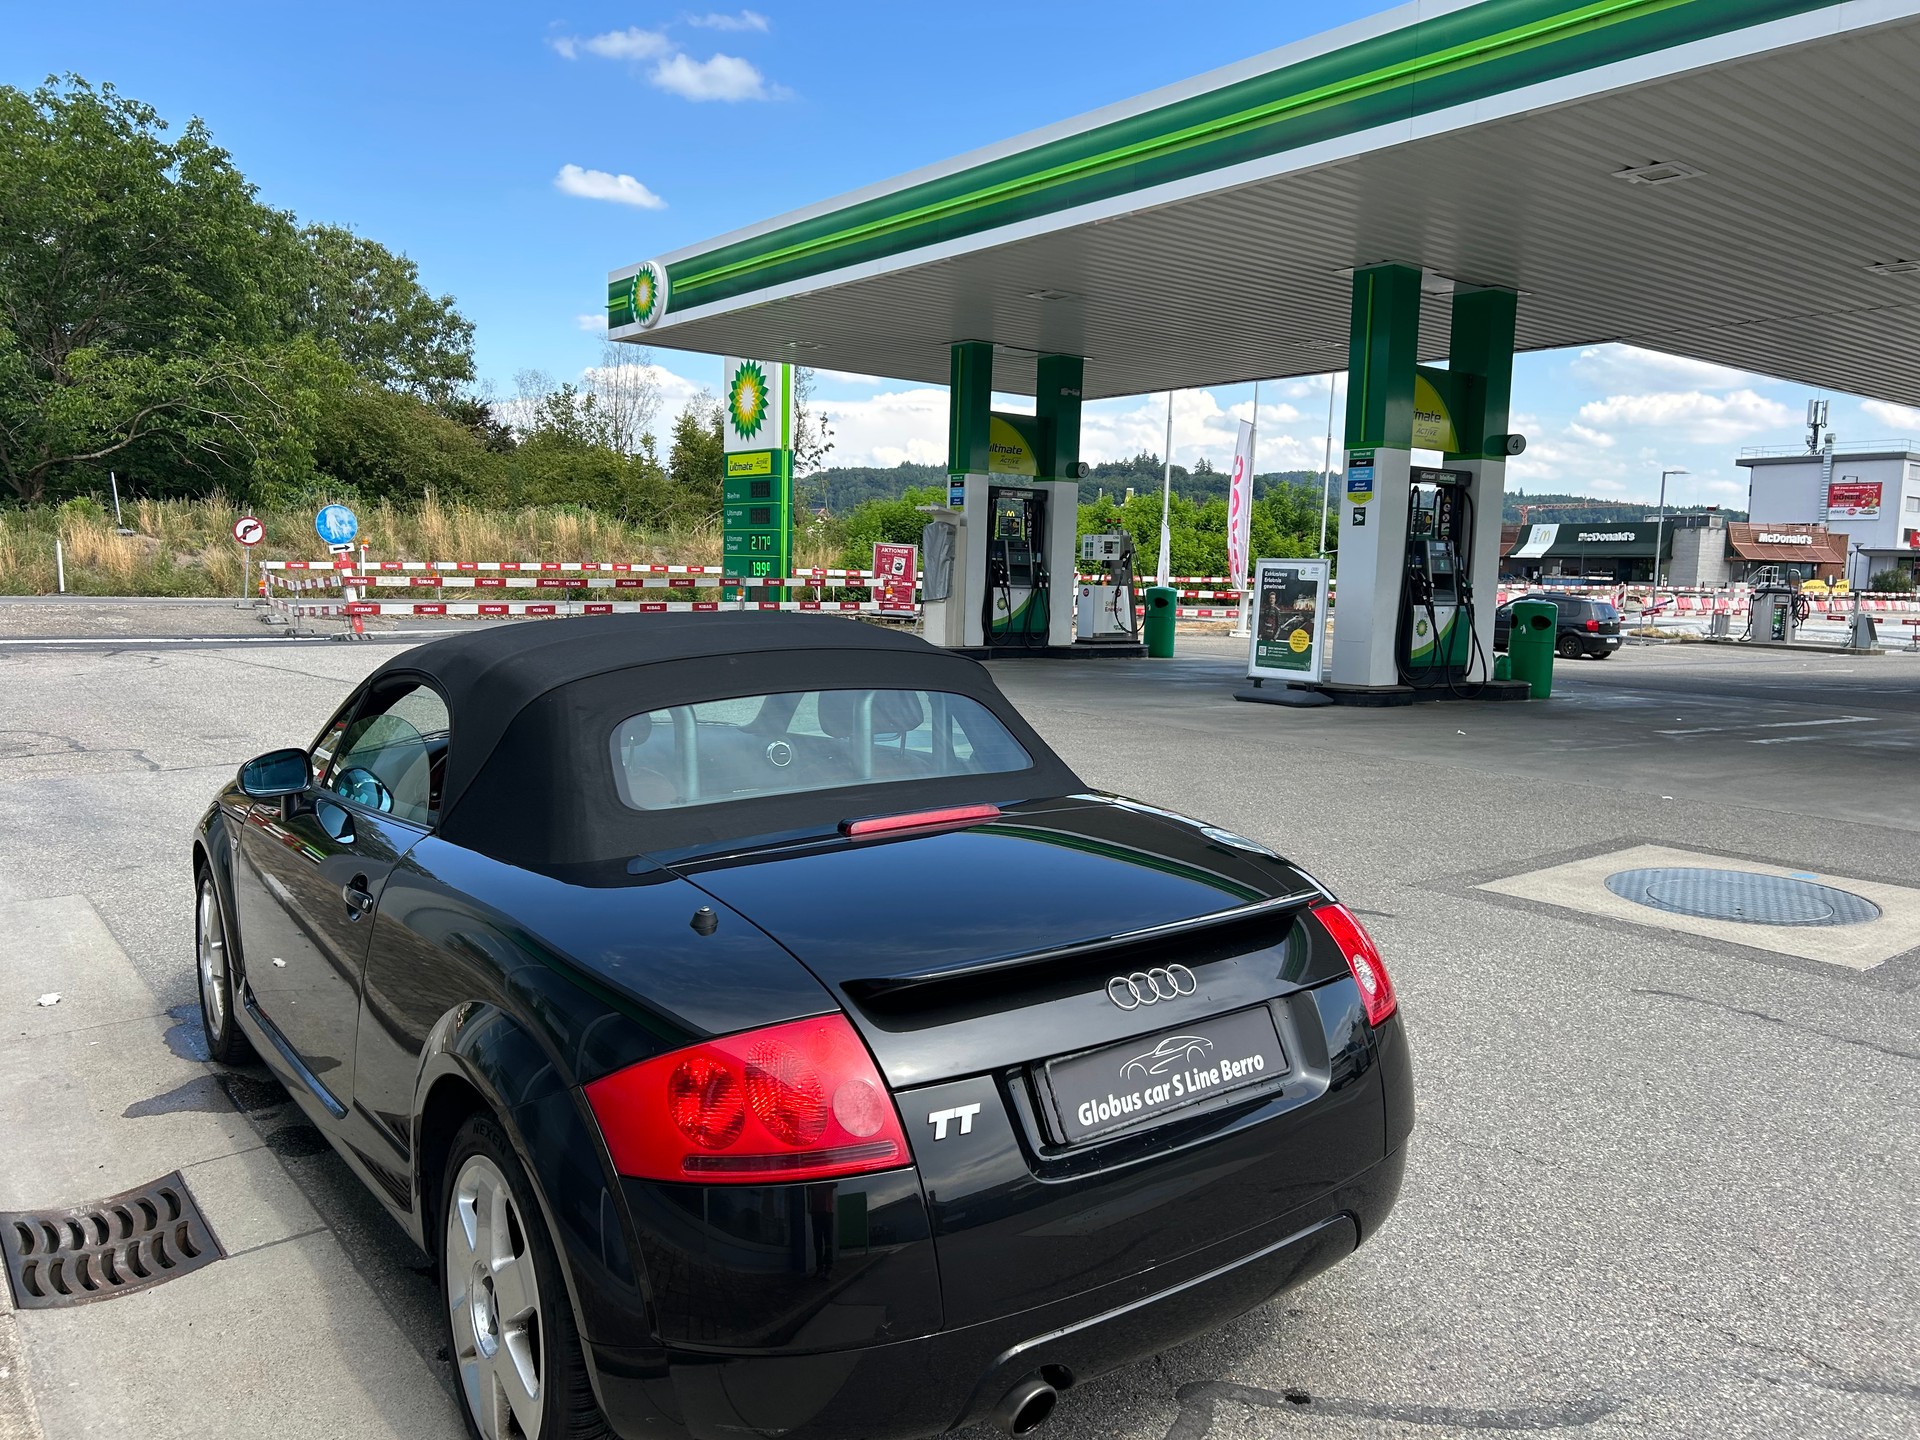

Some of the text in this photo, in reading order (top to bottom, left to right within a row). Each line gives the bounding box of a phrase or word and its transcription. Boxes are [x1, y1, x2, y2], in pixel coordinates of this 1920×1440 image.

[1413, 408, 1442, 424] imate
[1415, 427, 1440, 437] ACTIVE
[1512, 439, 1519, 450] 4
[729, 461, 753, 472] ultimate
[1081, 465, 1086, 475] 2
[1578, 531, 1636, 542] McDonald's
[1758, 532, 1813, 545] McDonald's
[1078, 1053, 1265, 1126] Globus car S Line Berro
[928, 1102, 981, 1141] TT
[472, 1121, 508, 1156] NEXEN
